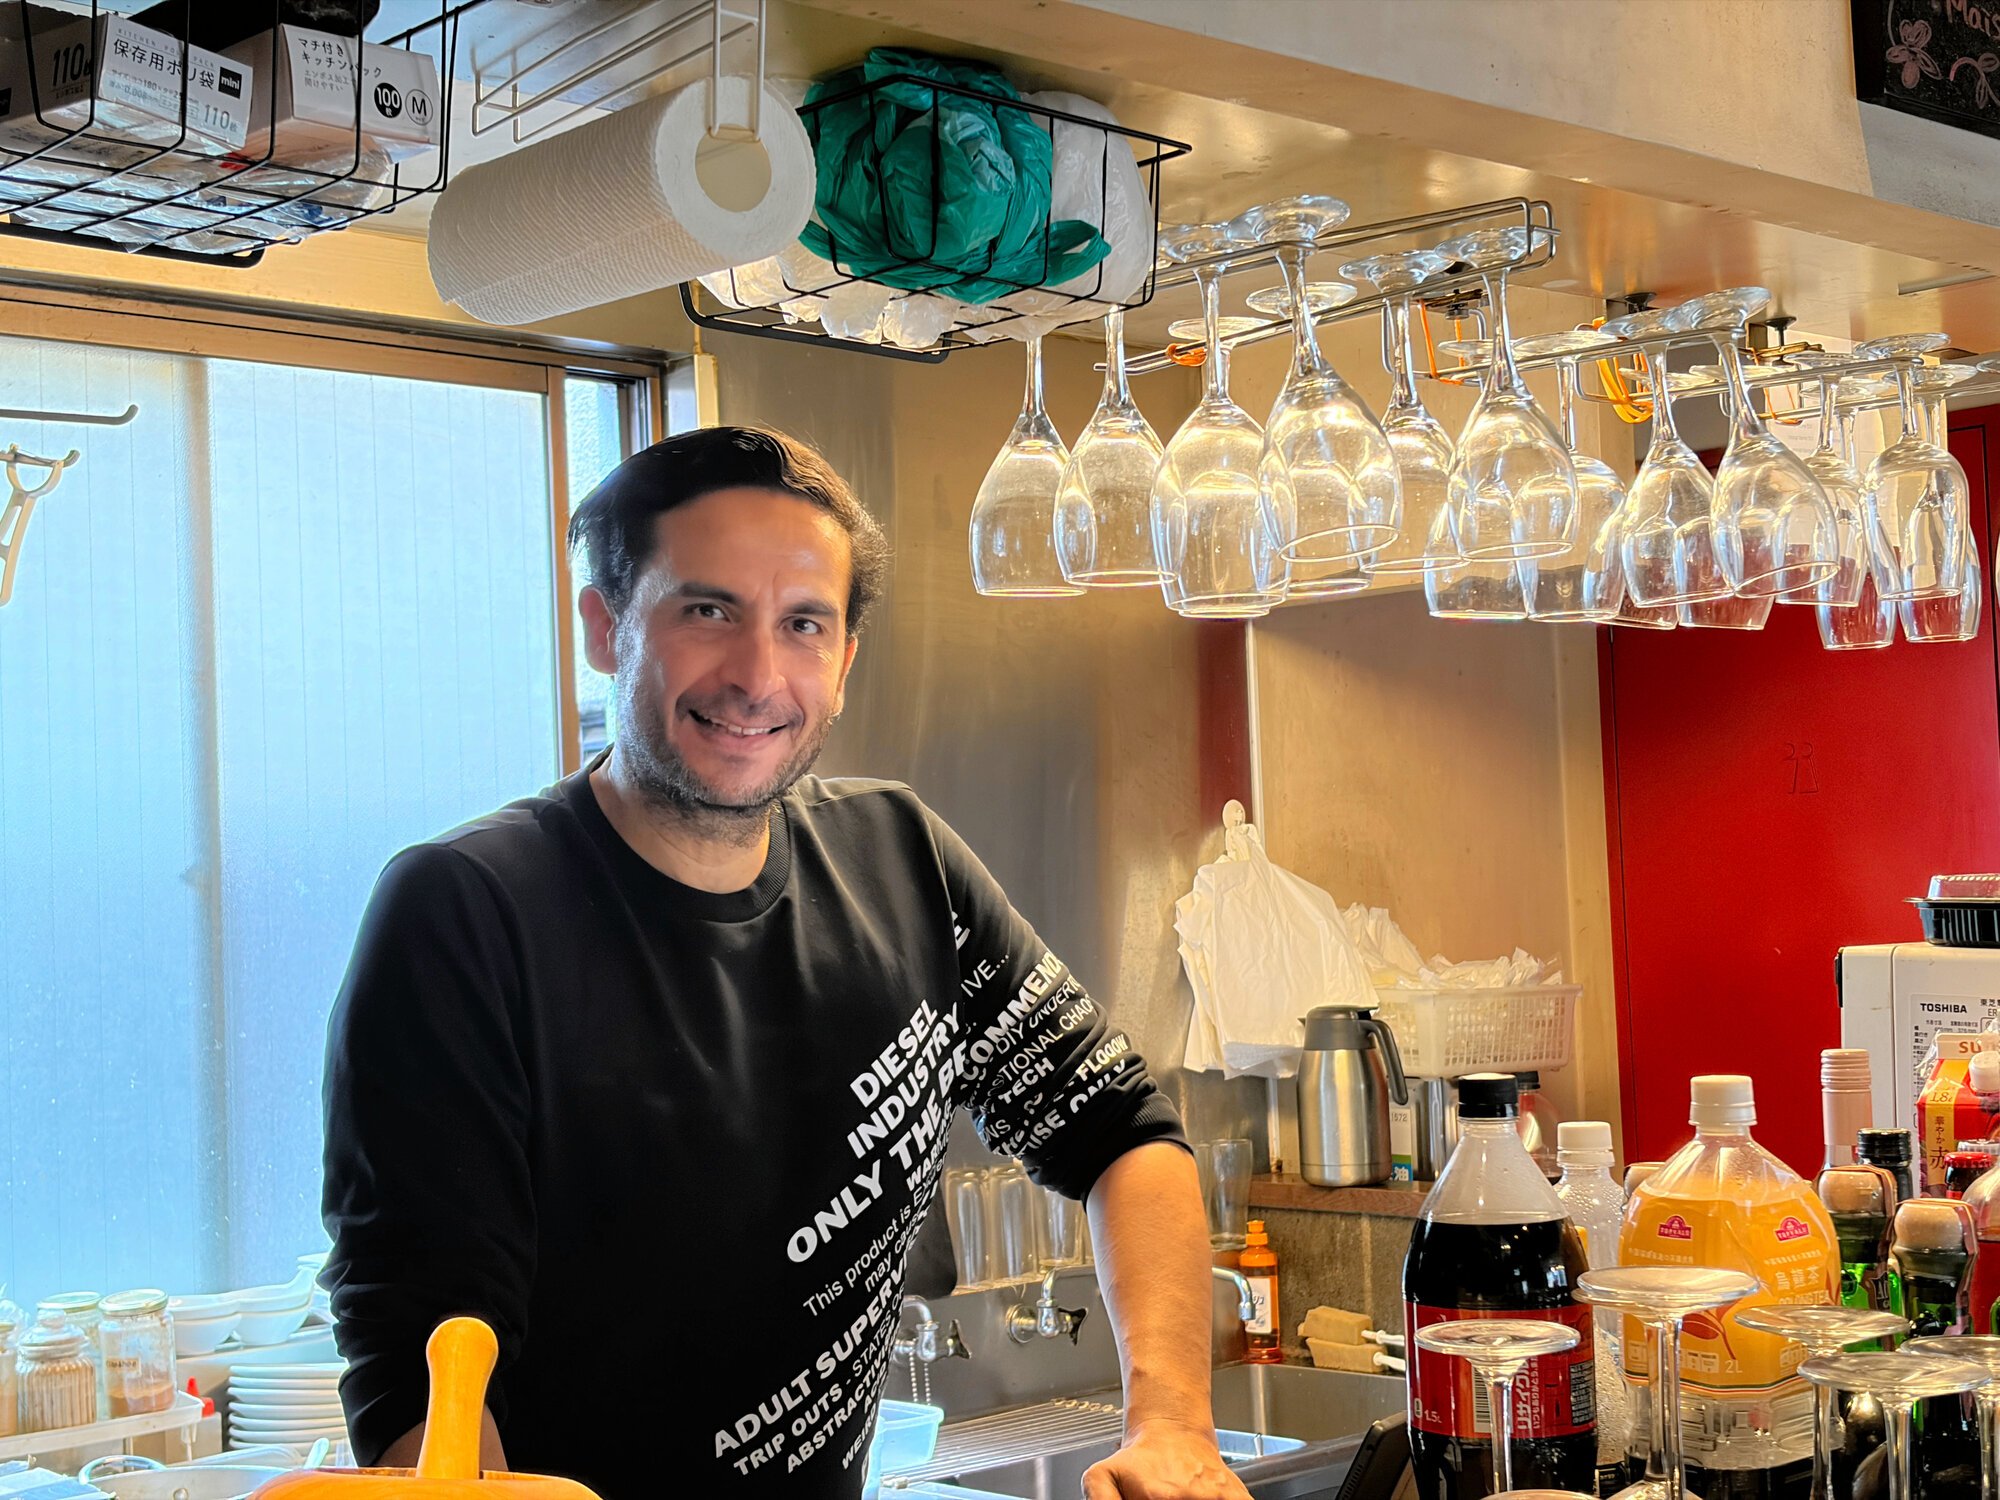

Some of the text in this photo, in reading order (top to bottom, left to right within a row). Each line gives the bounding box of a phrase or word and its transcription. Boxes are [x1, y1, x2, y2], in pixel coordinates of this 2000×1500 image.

[298, 38, 344, 57] マチ付き
[220, 75, 240, 91] mini
[376, 86, 400, 109] 100
[412, 96, 427, 117] M
[1919, 1002, 1968, 1013] TOSHIBA
[850, 999, 938, 1108] DIESEL
[847, 1001, 960, 1159] INDUSTRY
[998, 1056, 1055, 1105] TECH
[786, 1158, 884, 1263] ONLY
[888, 1088, 942, 1171] THE
[802, 1280, 844, 1317] This
[845, 1218, 900, 1288] product
[900, 1204, 911, 1224] is
[864, 1252, 891, 1293] may
[1724, 1360, 1744, 1374] 2L
[715, 1368, 812, 1459] ADULT
[733, 1432, 786, 1476] TRIP
[791, 1383, 843, 1437] OUTS
[852, 1309, 892, 1377] STATES
